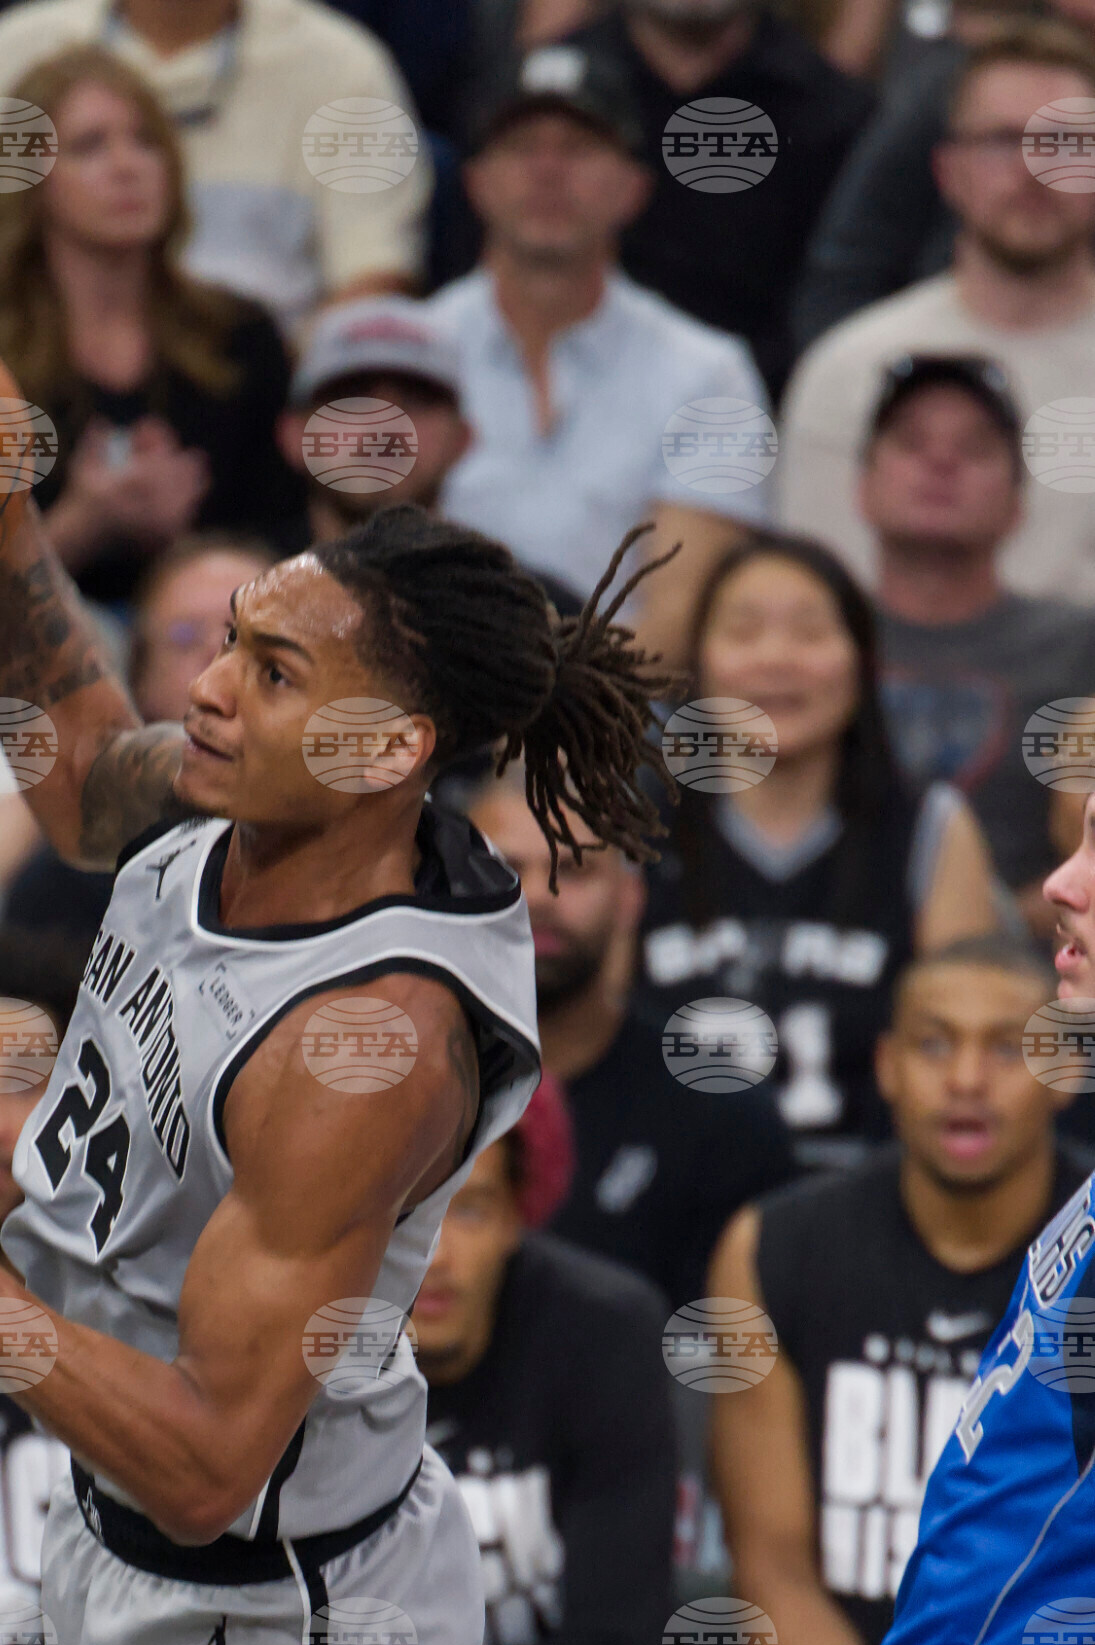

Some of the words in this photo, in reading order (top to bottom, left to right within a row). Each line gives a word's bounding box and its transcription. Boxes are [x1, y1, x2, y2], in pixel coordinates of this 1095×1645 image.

[116, 964, 190, 1184] ANTONIO
[210, 976, 243, 1026] LEDGER
[34, 1034, 131, 1264] 24
